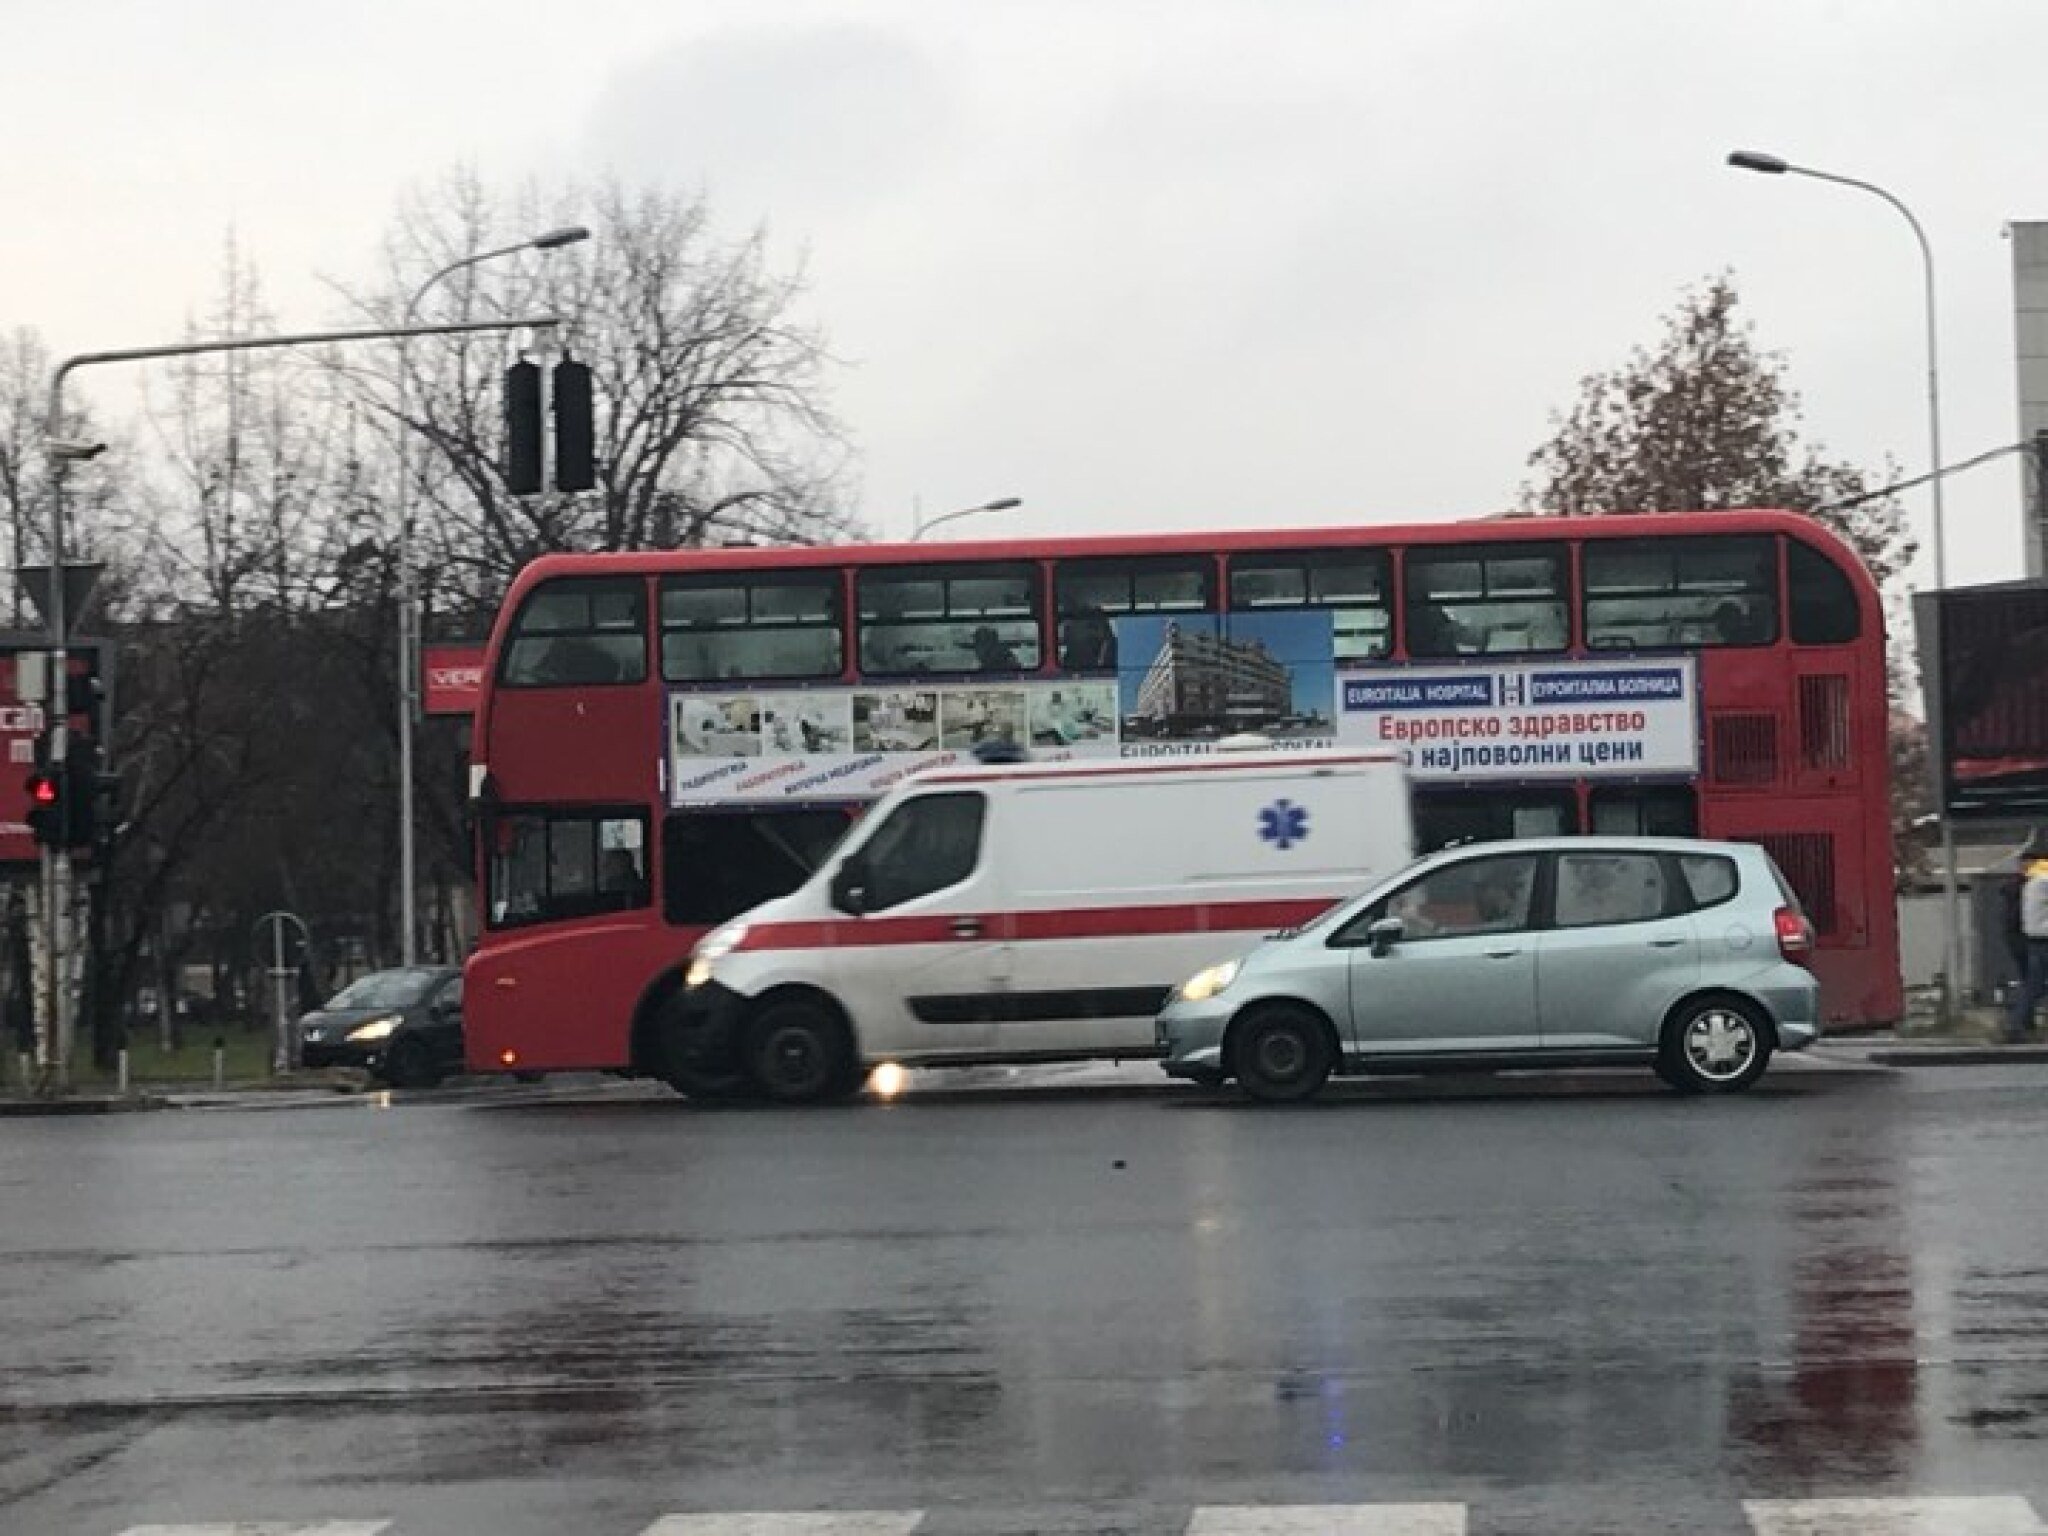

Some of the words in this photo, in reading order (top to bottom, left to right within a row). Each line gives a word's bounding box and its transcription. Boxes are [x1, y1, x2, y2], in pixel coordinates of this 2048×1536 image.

[1378, 714, 1502, 742] Европско
[1508, 710, 1646, 739] здравство
[1420, 740, 1571, 771] најповолни
[1578, 739, 1643, 766] цени
